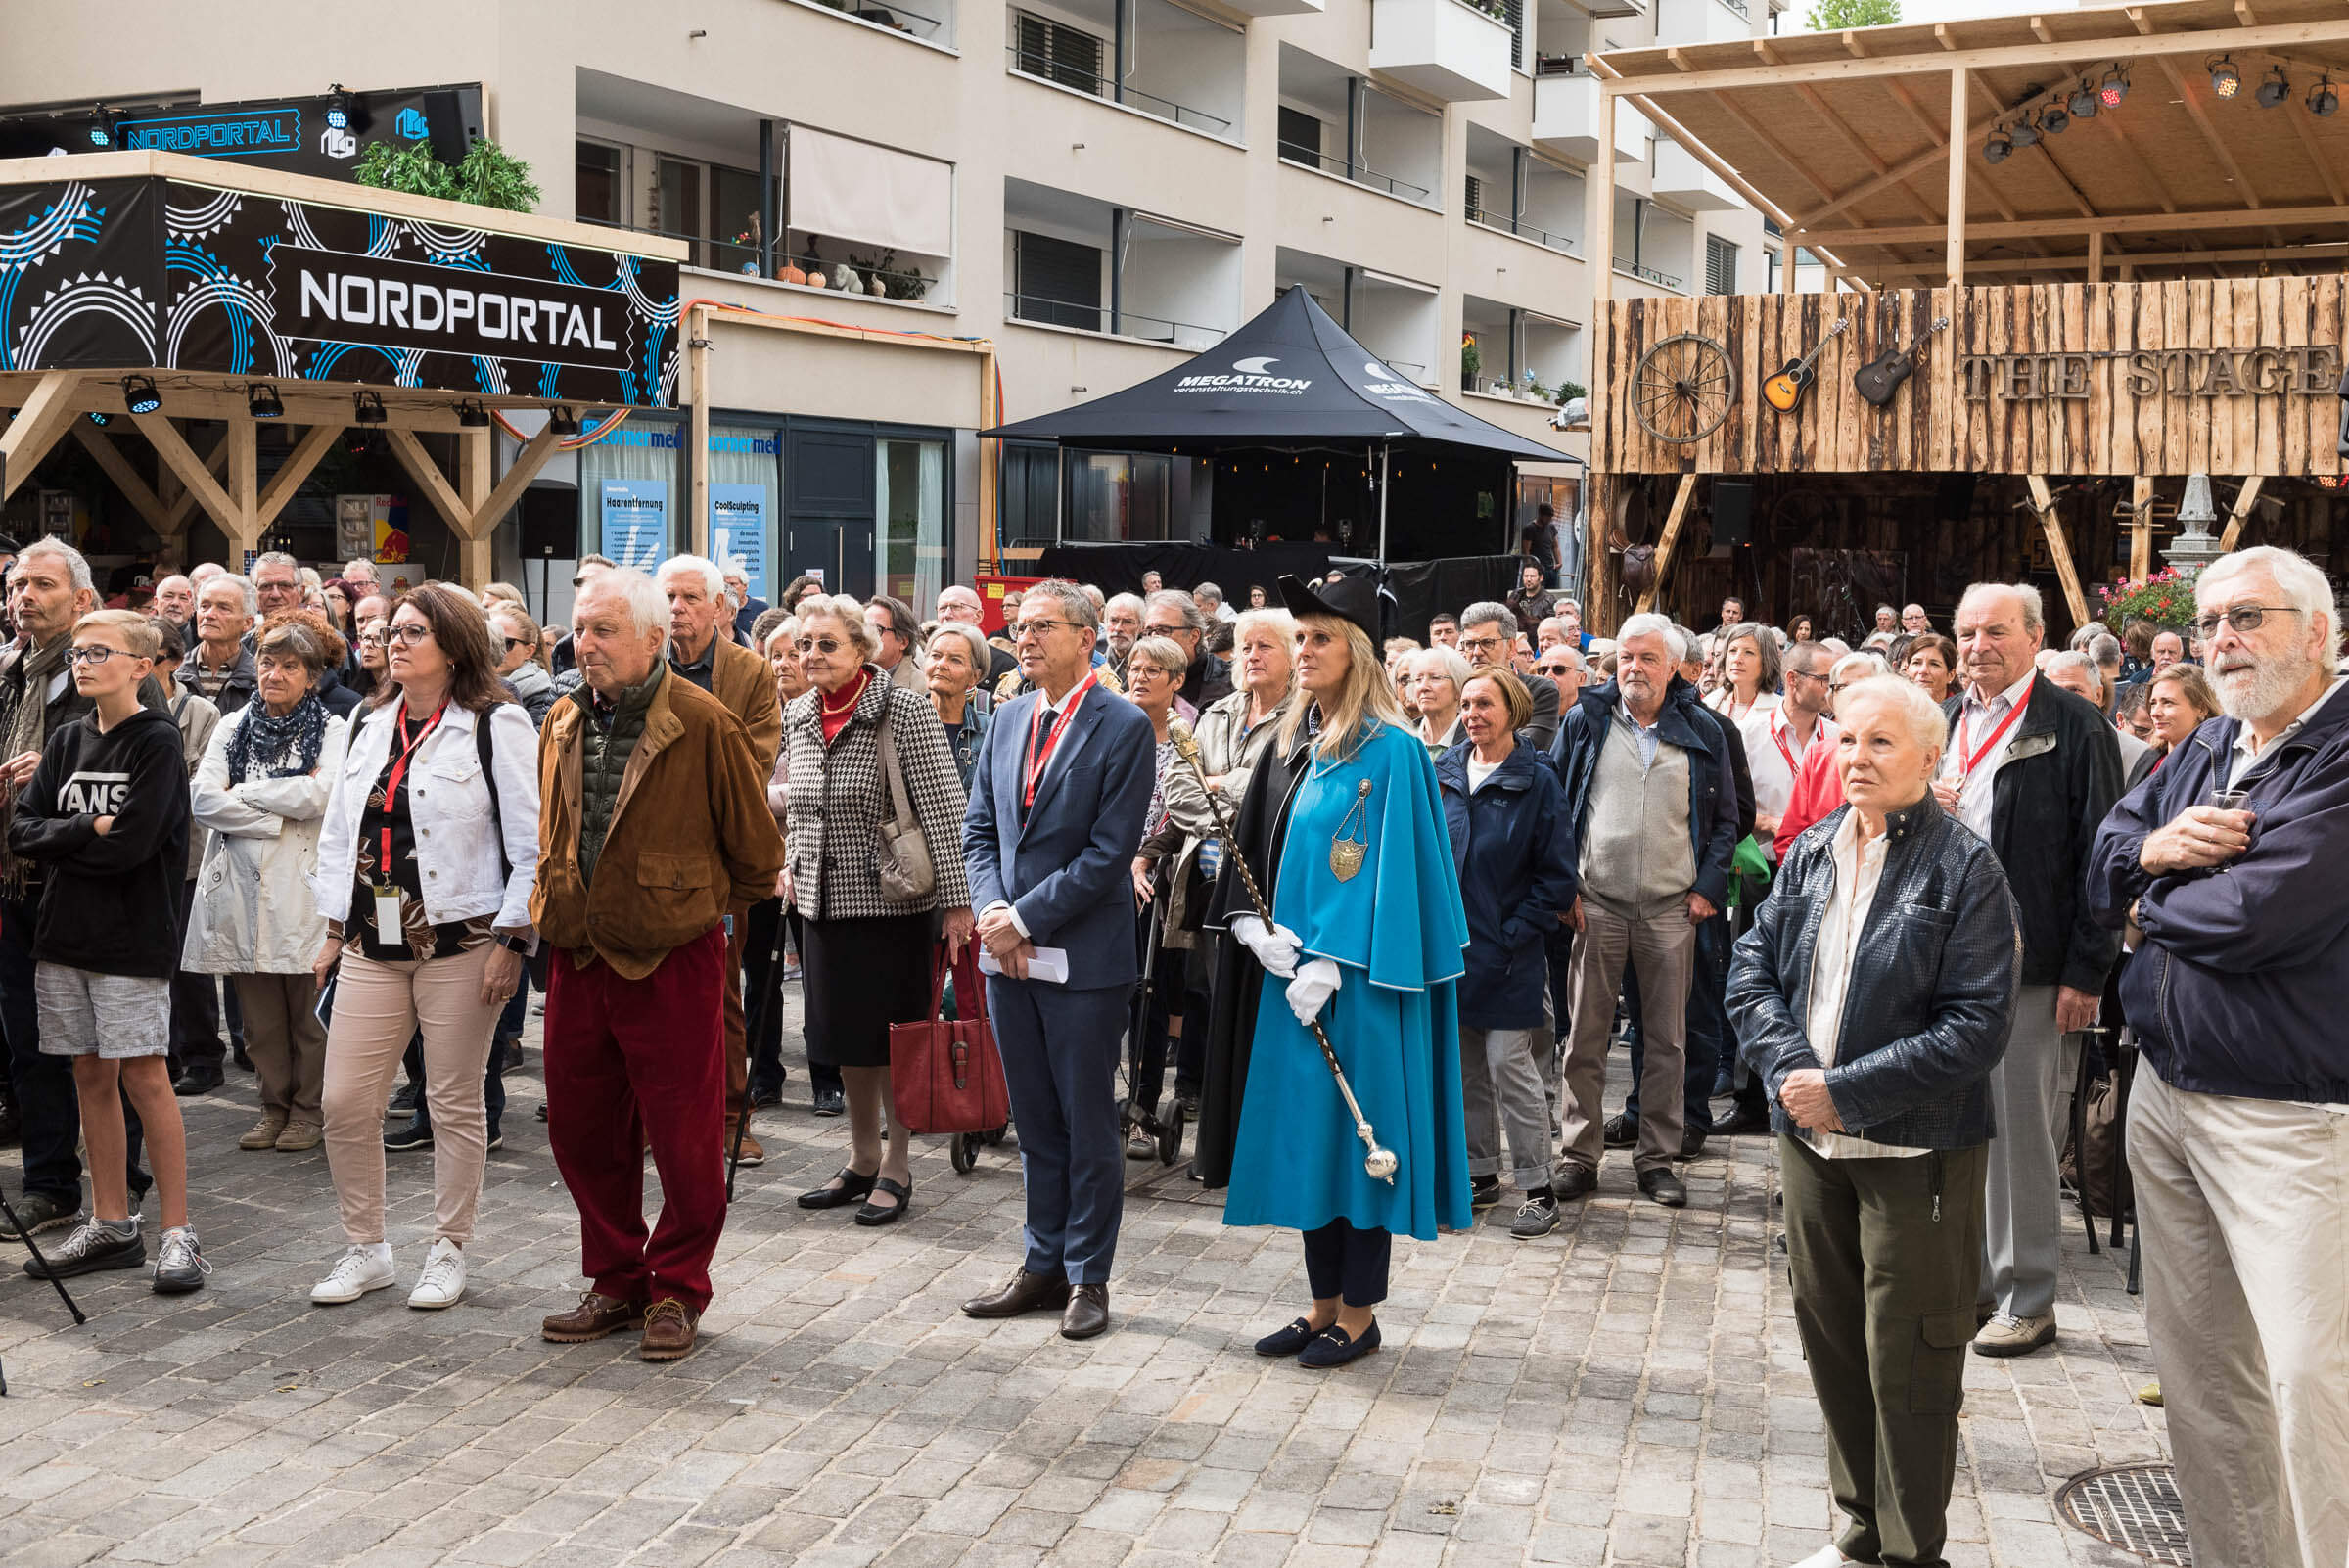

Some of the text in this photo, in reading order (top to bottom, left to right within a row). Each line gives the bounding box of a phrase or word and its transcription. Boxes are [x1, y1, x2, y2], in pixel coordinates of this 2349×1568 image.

[127, 118, 291, 151] NORDPORTAL
[300, 269, 617, 351] NORDPORTAL
[1177, 375, 1313, 390] MEGATRON
[1958, 345, 2340, 400] THE STAGE
[1174, 385, 1304, 395] veranstaltungstechnik.ch
[601, 423, 682, 449] cornermed
[708, 431, 782, 455] cornermed
[606, 496, 664, 512] Haarentfernung
[714, 500, 760, 514] CoolSculpting
